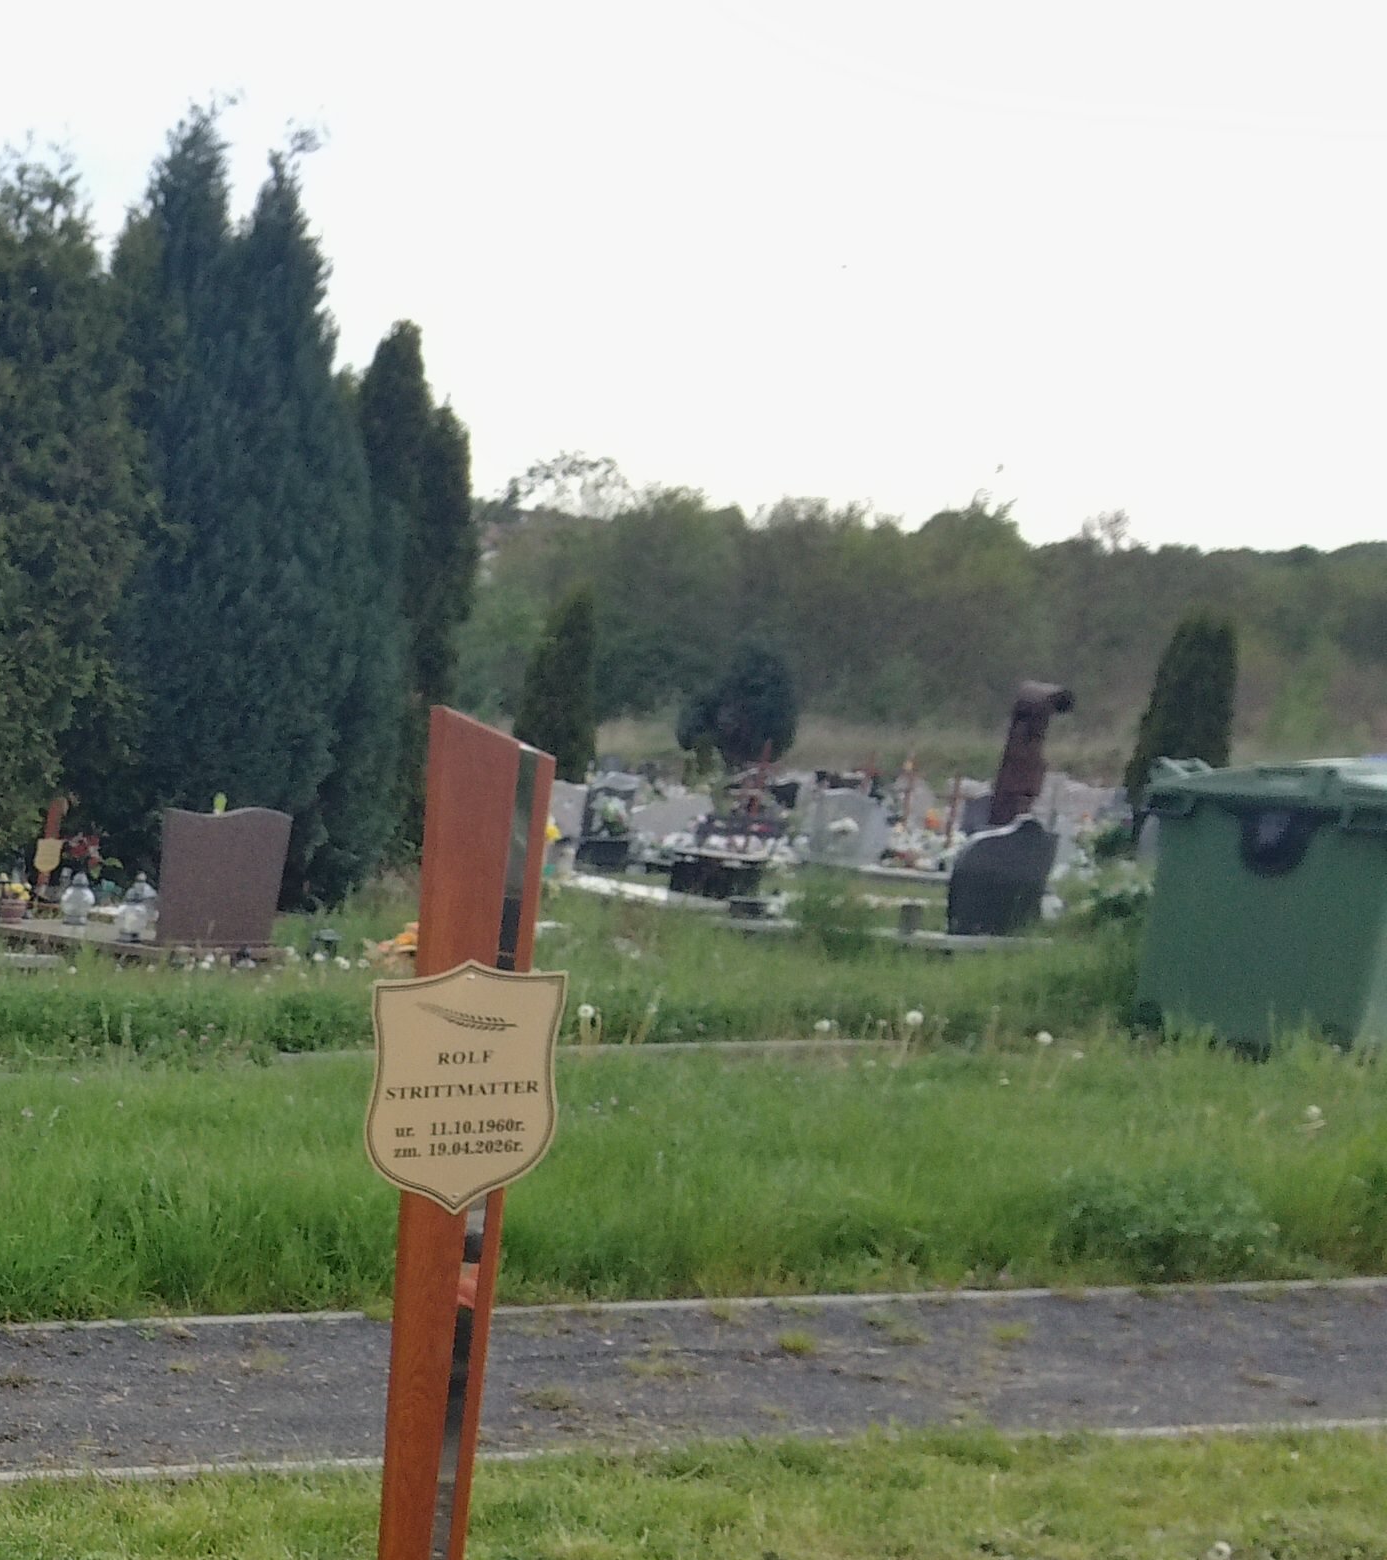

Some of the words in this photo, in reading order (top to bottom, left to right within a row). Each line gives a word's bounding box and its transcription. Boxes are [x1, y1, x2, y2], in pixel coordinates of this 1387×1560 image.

[437, 1051, 494, 1066] ROLF
[385, 1080, 539, 1101] STRITTMATTER
[395, 1126, 415, 1138] ur.
[429, 1119, 525, 1137] 11.10.1960r.
[428, 1140, 524, 1157] 19.04.2026r.
